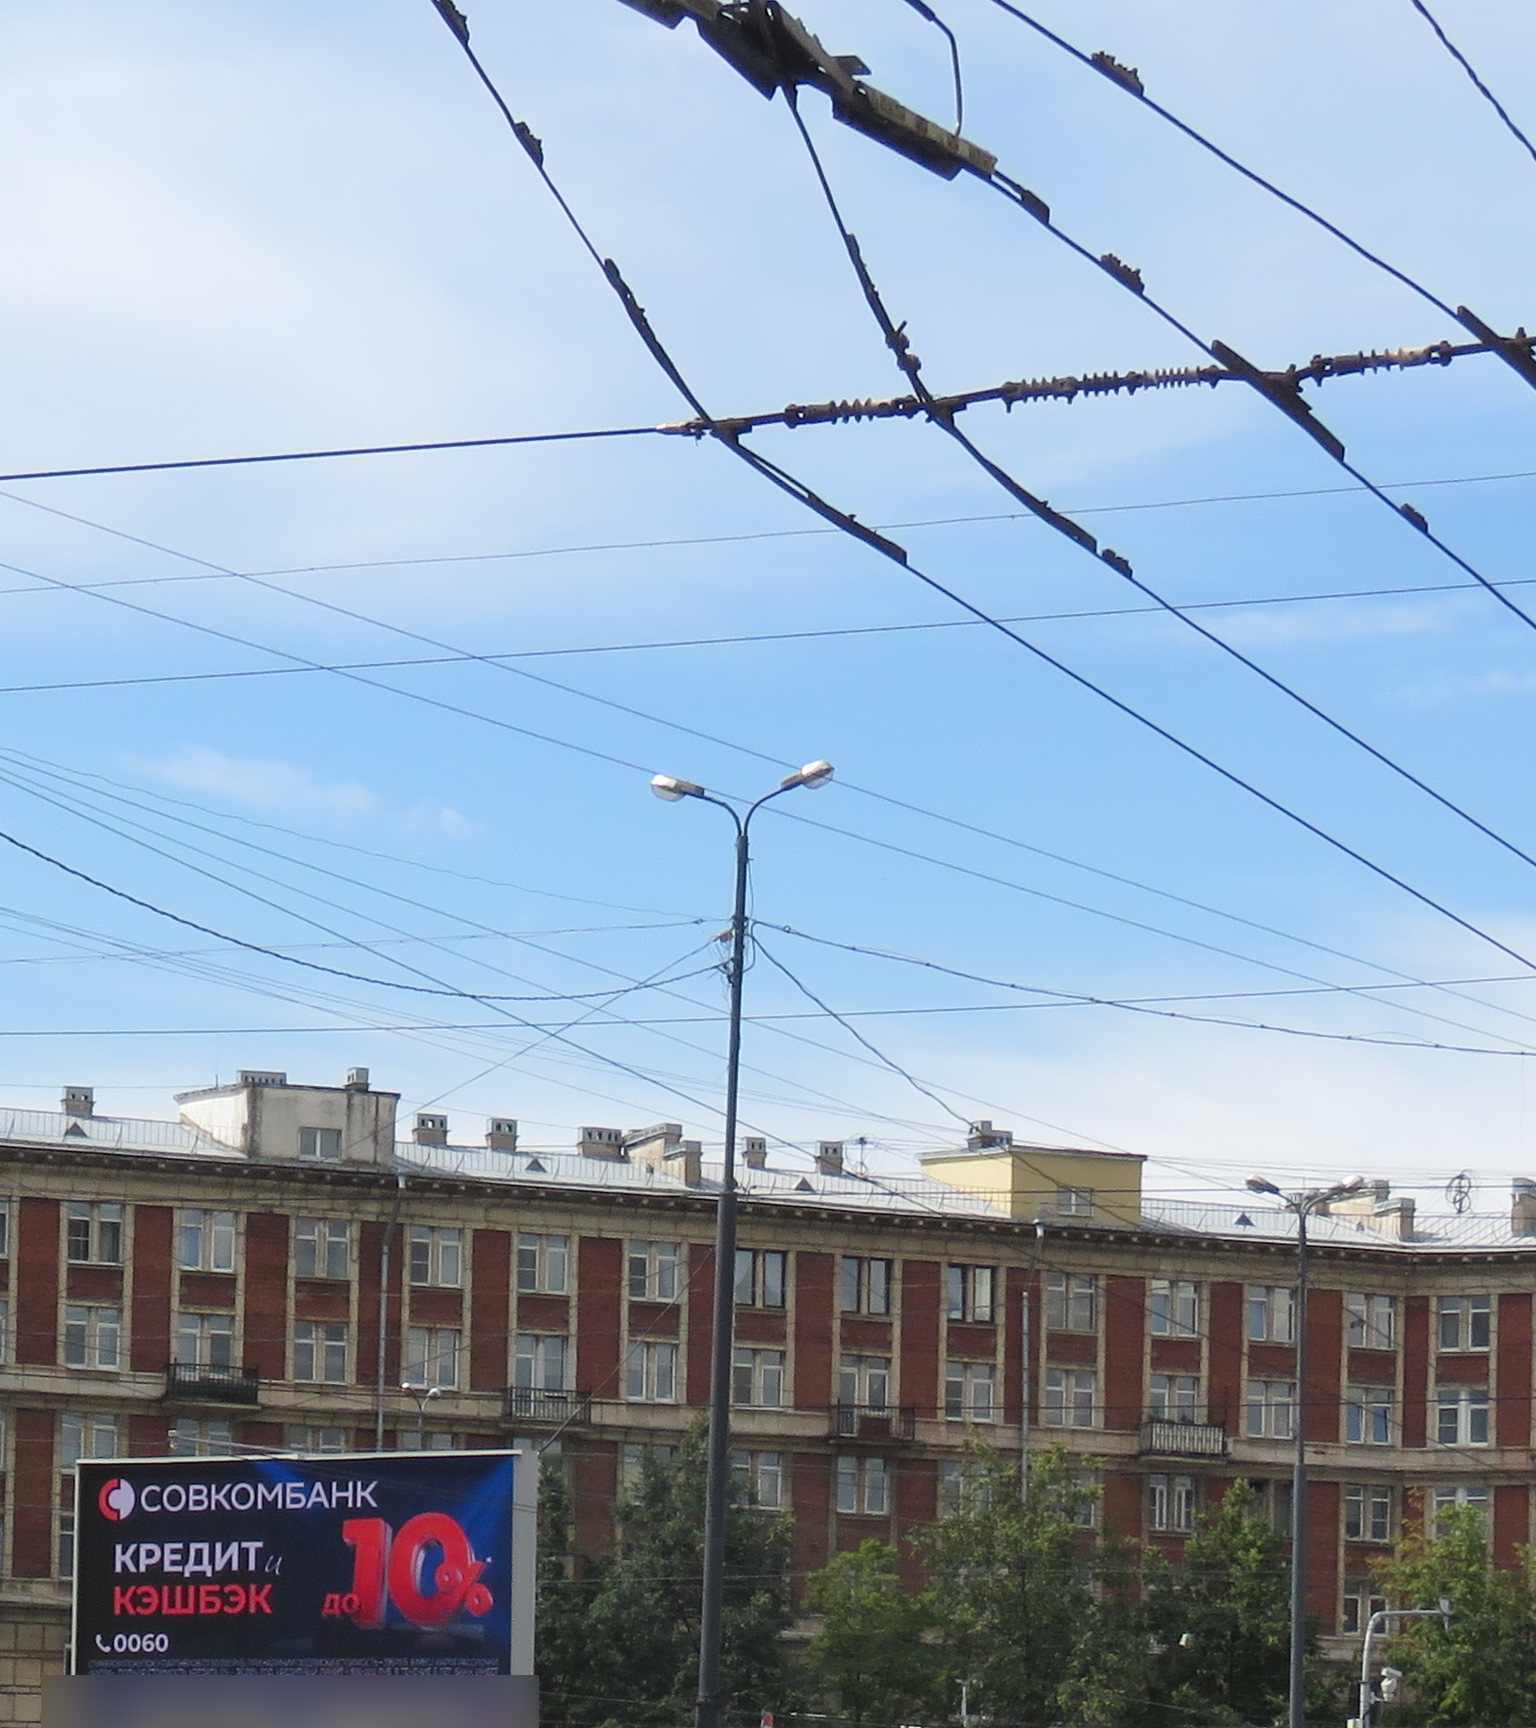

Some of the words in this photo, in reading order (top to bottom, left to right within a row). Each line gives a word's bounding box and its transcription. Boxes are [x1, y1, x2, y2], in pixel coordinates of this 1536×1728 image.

[140, 1480, 378, 1512] СОВКОМБАНК
[114, 1541, 264, 1577] КРЕДИТ
[114, 1584, 272, 1616] КЭШБЭК
[321, 1593, 361, 1616] до
[113, 1633, 169, 1653] 0060
